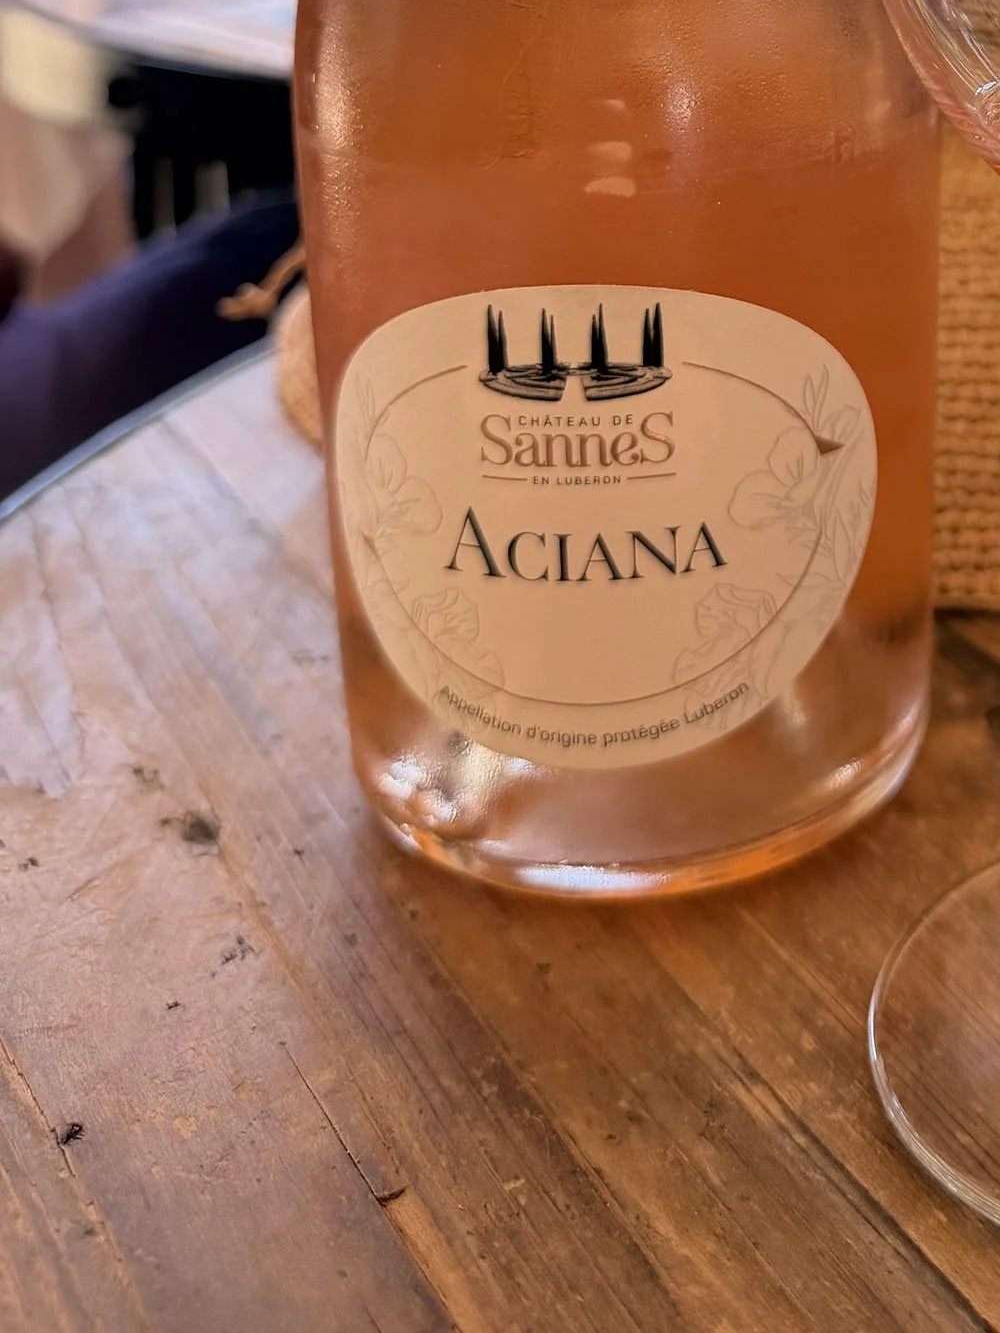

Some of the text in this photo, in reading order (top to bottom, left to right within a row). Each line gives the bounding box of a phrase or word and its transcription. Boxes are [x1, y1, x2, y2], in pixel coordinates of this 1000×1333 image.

[518, 413, 634, 428] CHÂTEAU DE
[532, 475, 622, 486] EN LUBERON
[444, 506, 729, 583] ACIANA
[438, 681, 750, 748] Appellation d'origine protégée Luberon
